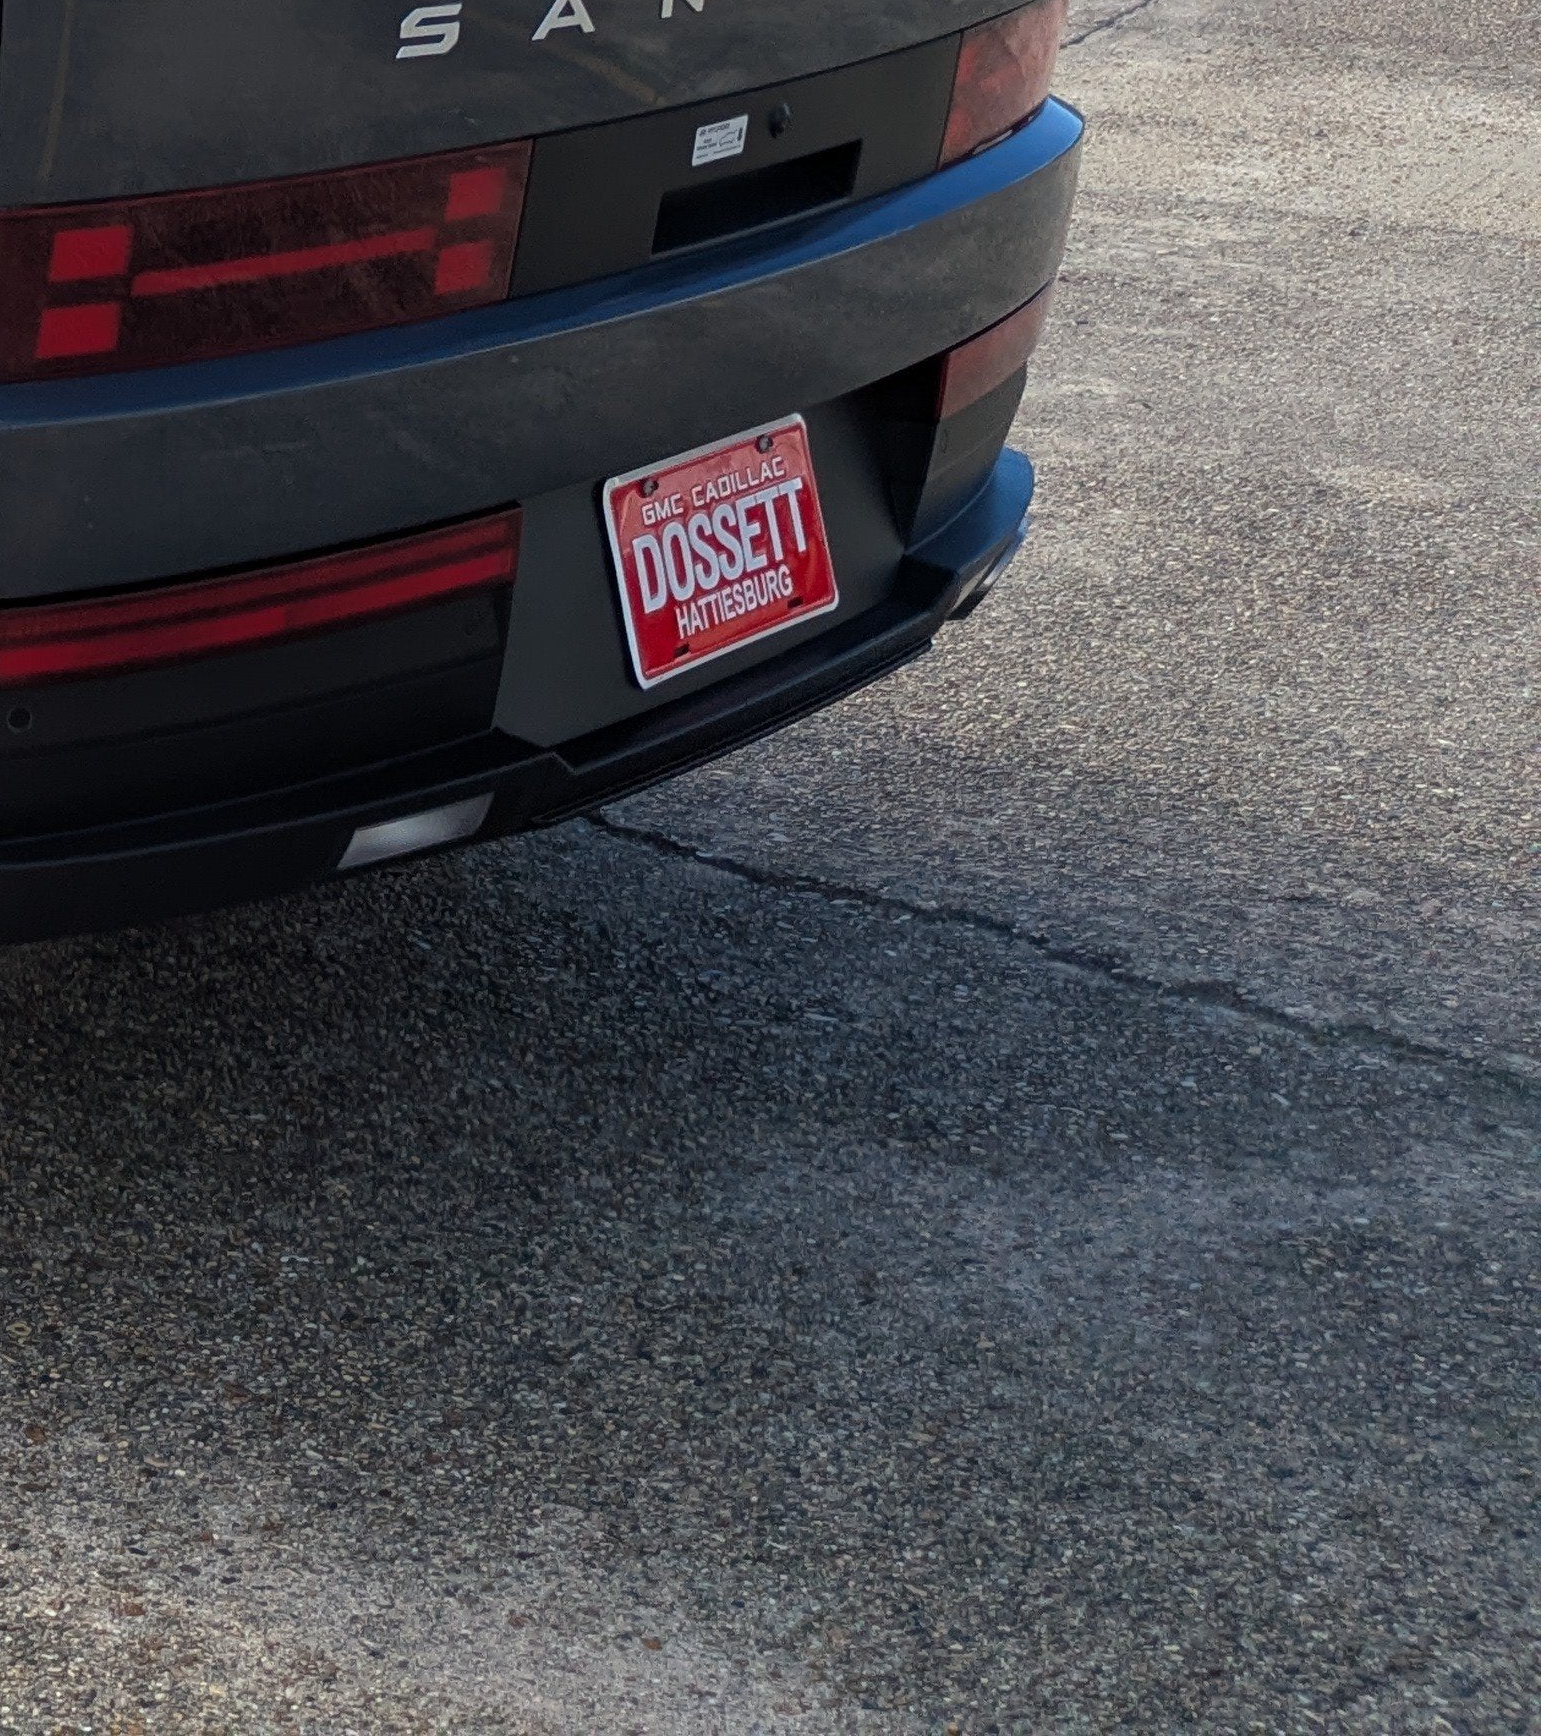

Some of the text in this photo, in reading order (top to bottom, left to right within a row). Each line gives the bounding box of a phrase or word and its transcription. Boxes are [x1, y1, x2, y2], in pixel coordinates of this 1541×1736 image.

[642, 456, 786, 525] GMC CADILLAC
[632, 477, 807, 614] DOSSETT
[675, 566, 794, 639] HATTIESBURG
